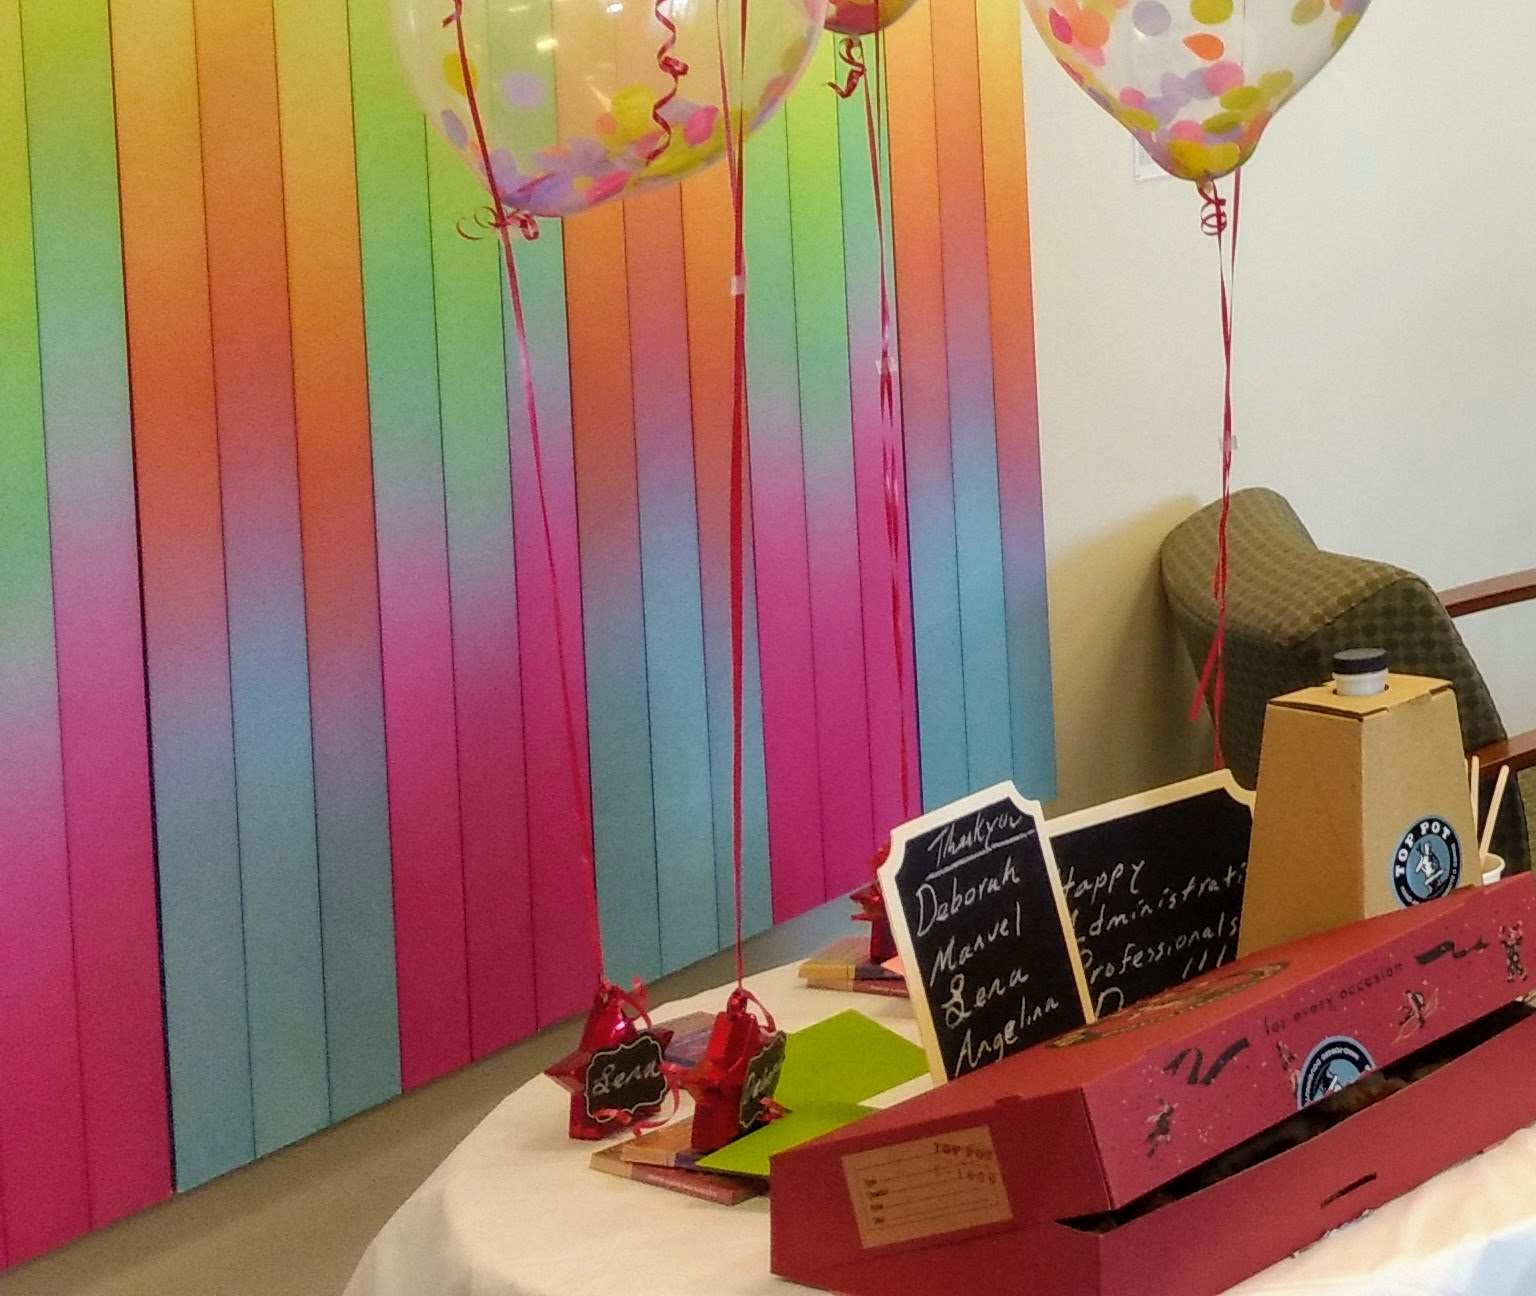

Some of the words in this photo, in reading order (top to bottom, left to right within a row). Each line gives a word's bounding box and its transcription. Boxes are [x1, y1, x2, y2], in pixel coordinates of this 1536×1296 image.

[1394, 832, 1415, 878] TOP
[1419, 820, 1451, 841] POT
[915, 855, 1020, 937] Deborah
[929, 900, 1021, 987] Manuel
[1339, 961, 1404, 1000] occasion
